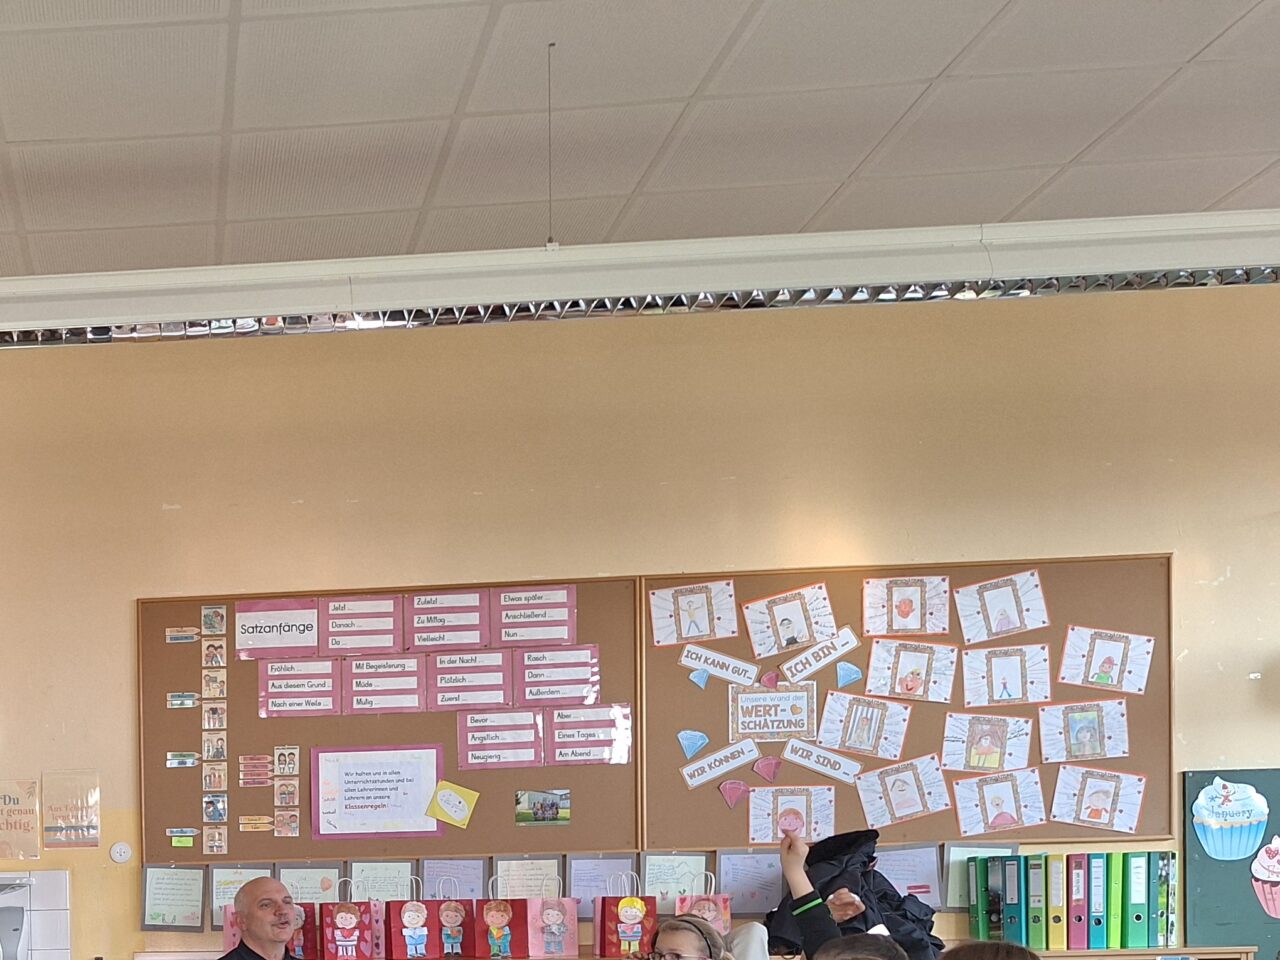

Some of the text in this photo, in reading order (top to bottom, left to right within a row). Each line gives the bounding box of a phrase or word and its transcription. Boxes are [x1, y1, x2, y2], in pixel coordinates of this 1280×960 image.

[416, 596, 438, 605] Zuletzt
[503, 593, 543, 603] Etwas später
[331, 603, 346, 612] Jetzt
[331, 620, 355, 629] Danach
[416, 616, 446, 626] Zu Mittag
[240, 622, 314, 636] Satzanfänge
[331, 638, 340, 646] Da
[416, 633, 445, 642] Vielleicht
[439, 655, 477, 665] In der Nacht
[527, 654, 547, 662] Rasch
[684, 649, 702, 662] ICH
[703, 655, 731, 672] KANN
[785, 658, 813, 678] ICH
[814, 641, 838, 662] BIN
[270, 664, 295, 673] Fröhlich
[354, 661, 406, 671] Mit Begeisterung
[439, 675, 466, 684] Plötzlich
[527, 671, 545, 679] Dann
[270, 680, 326, 689] Aus diesem Grund
[355, 679, 373, 688] Müde
[528, 688, 560, 697] Außerdem
[355, 697, 373, 707] Mutig
[440, 694, 460, 703] Zuerst
[740, 695, 768, 703] Unsere
[791, 694, 805, 702] der
[270, 699, 322, 708] Nach einer Weile
[556, 711, 572, 719] Aber
[740, 704, 787, 718] WERT-
[469, 715, 488, 724] Bevor
[740, 718, 805, 730] SCHÄTZUNG
[557, 730, 596, 740] Eines Tages
[471, 752, 501, 761] Neugierig
[570, 749, 591, 757] Abend
[790, 744, 813, 761] WIR
[814, 754, 842, 772] SIND
[686, 765, 708, 780] WIR
[708, 747, 746, 770] KÖNNEN
[0, 794, 20, 806] Du
[6, 808, 35, 819] genau
[1208, 805, 1254, 821] January
